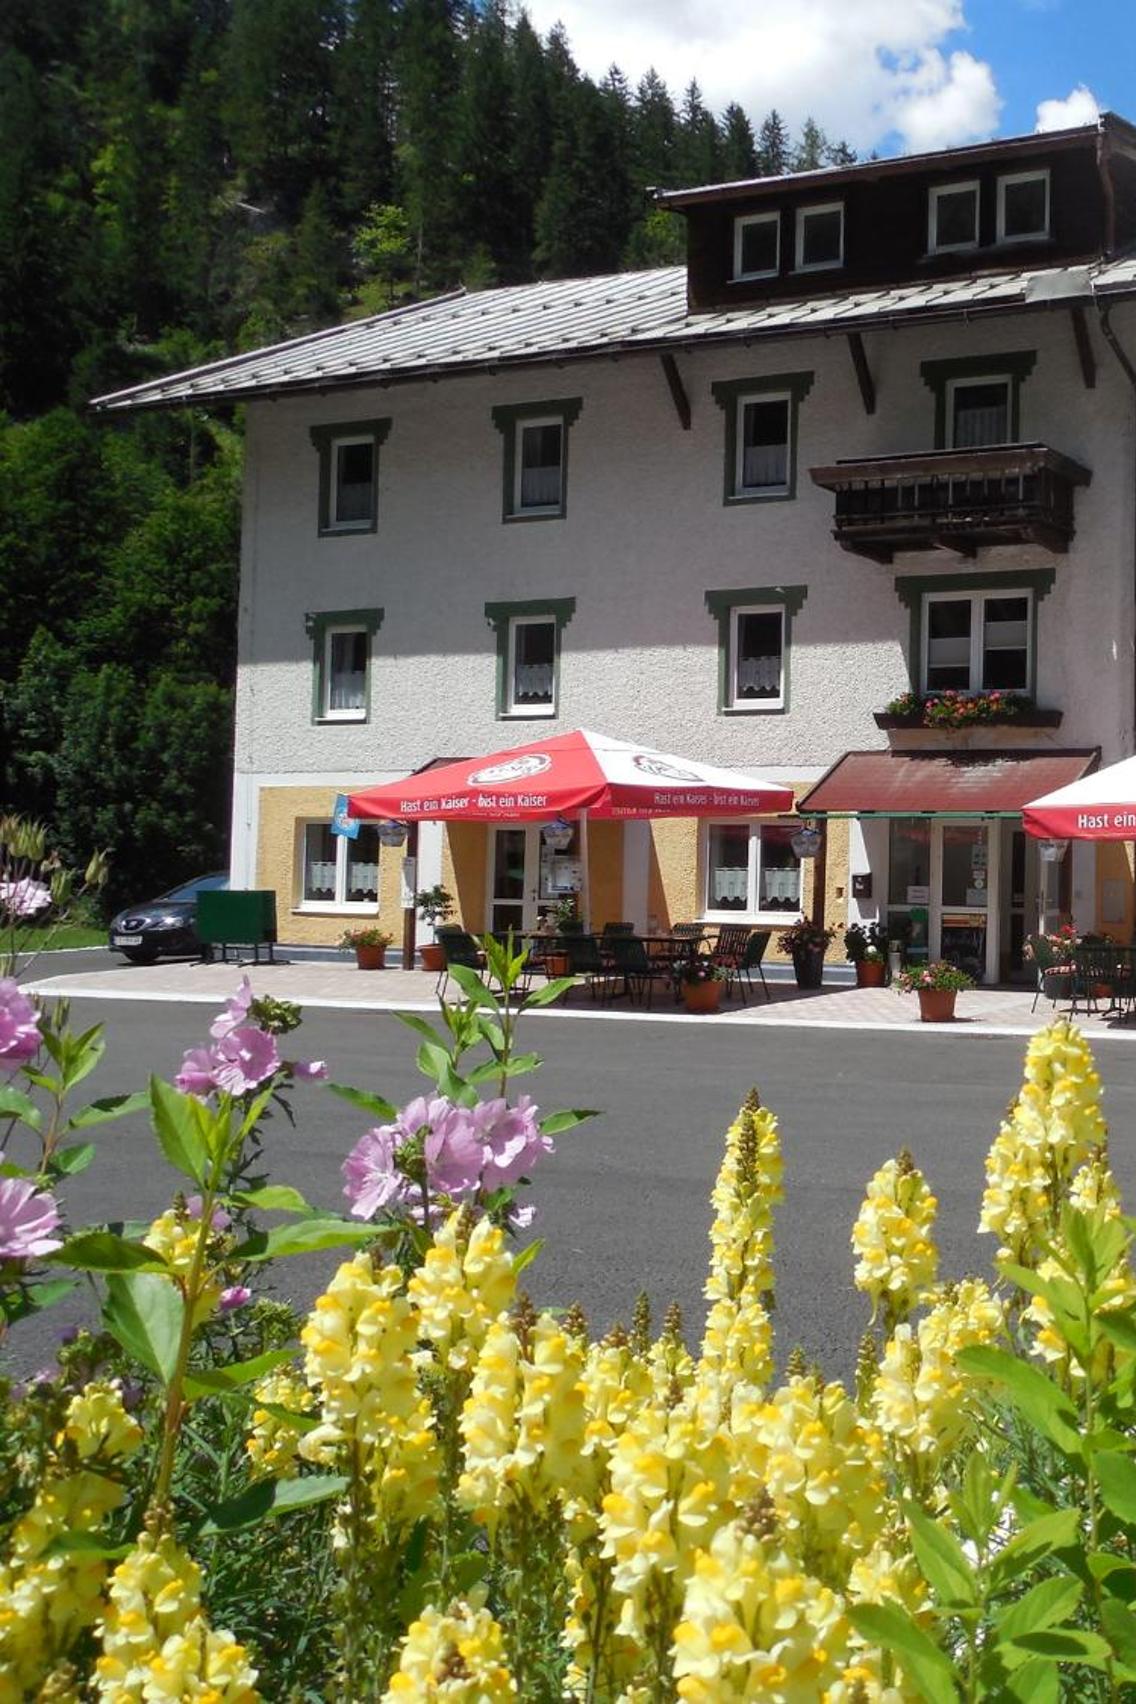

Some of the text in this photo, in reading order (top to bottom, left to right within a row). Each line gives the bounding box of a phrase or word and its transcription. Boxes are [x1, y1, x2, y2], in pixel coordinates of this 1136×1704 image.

[400, 800, 421, 813] Hast
[423, 799, 439, 811] ein
[441, 796, 470, 809] Kaiser
[478, 794, 497, 808] bist
[500, 794, 515, 807] ein
[517, 794, 547, 807] Kaiser
[1078, 814, 1109, 829] Hast
[1114, 813, 1136, 827] ein
